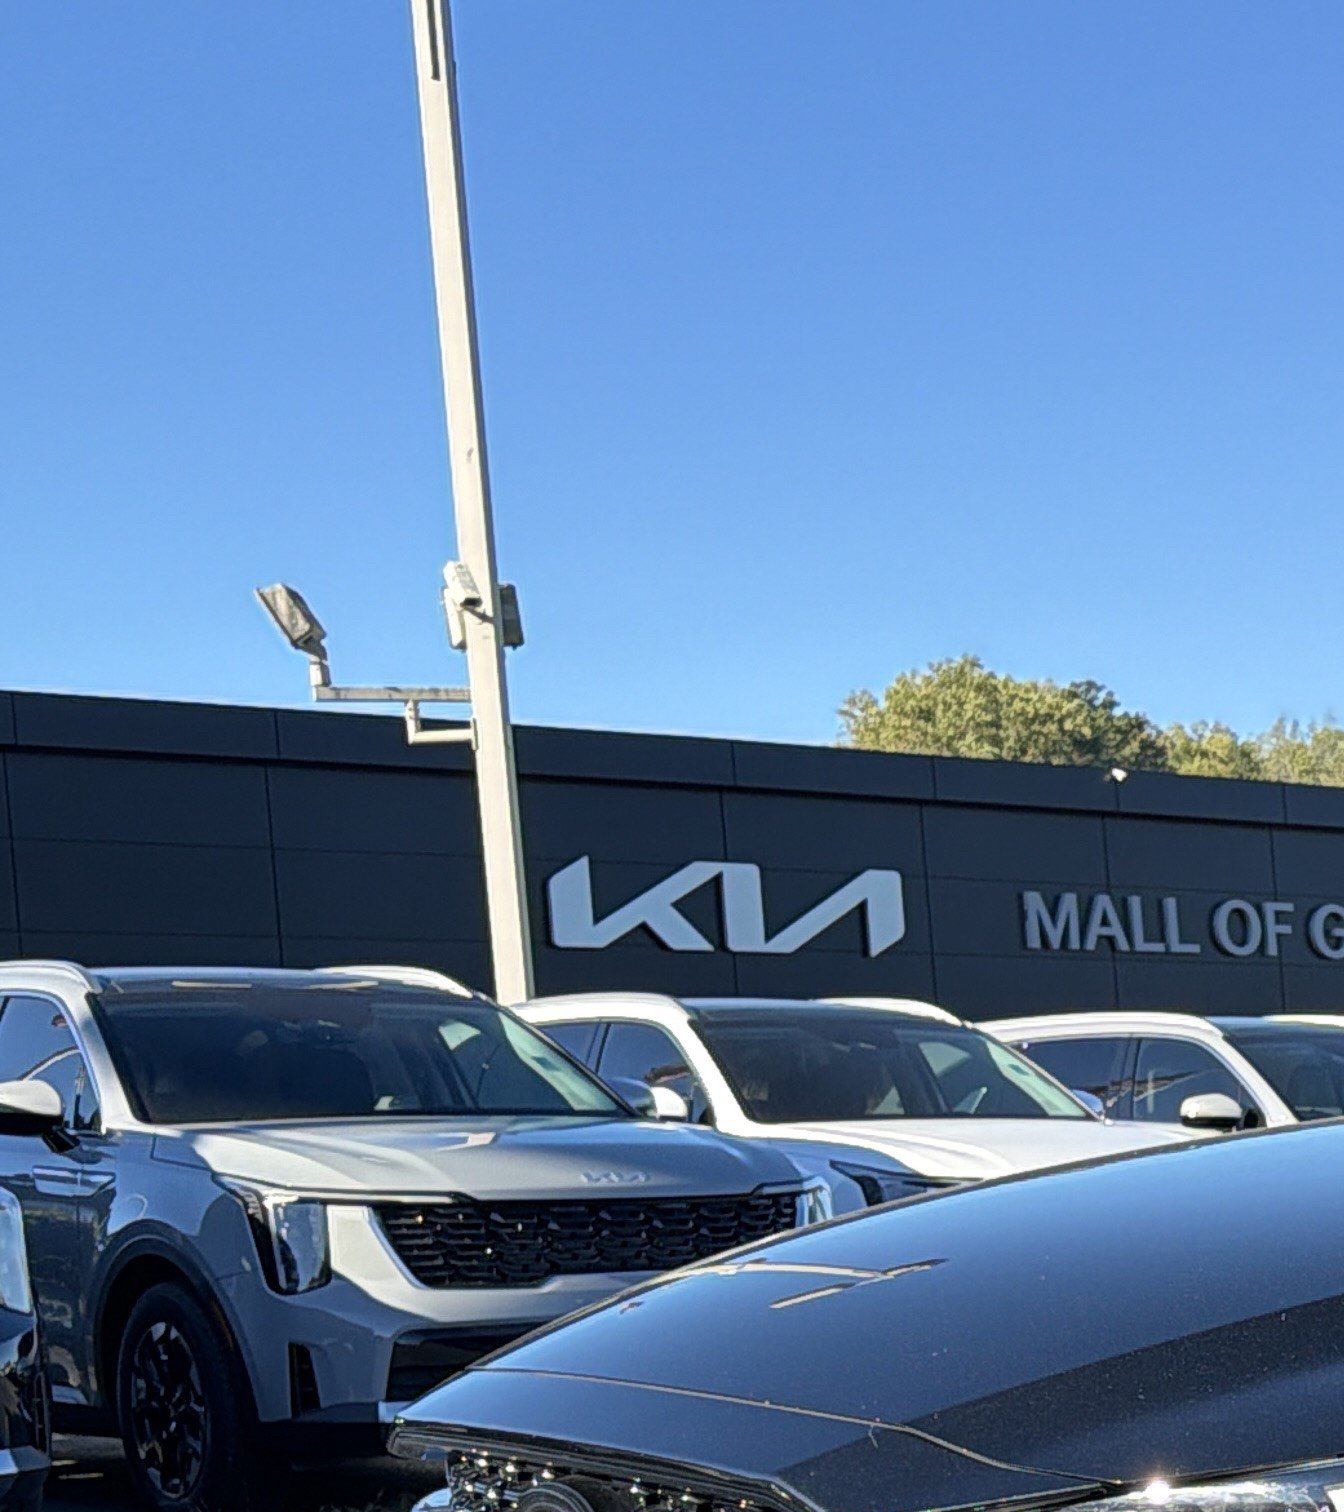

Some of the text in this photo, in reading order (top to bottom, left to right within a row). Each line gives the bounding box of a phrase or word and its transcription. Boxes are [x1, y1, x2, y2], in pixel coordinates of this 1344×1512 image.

[549, 855, 905, 958] KIA
[1023, 891, 1201, 953] MALL
[1213, 899, 1295, 957] OF
